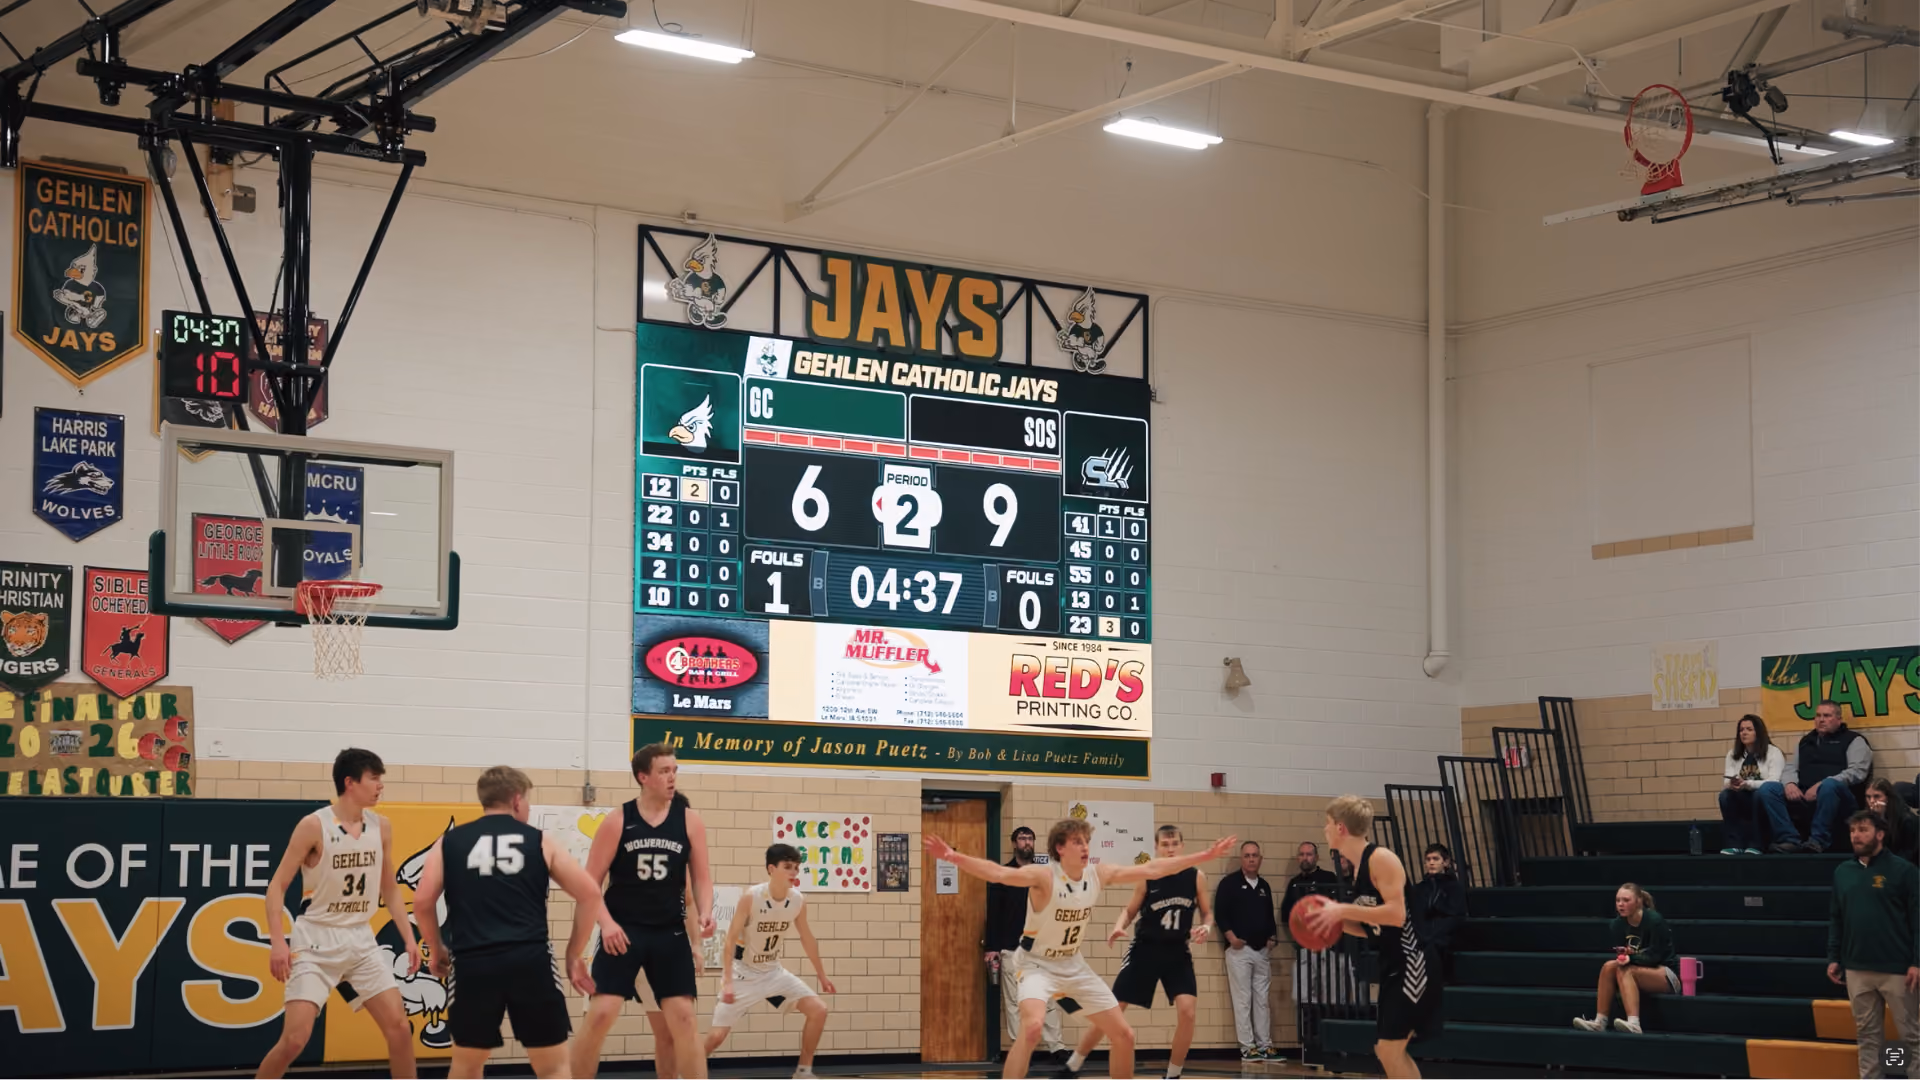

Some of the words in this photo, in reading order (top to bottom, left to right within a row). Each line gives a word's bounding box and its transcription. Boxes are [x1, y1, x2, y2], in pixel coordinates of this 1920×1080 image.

[36, 177, 132, 215] GEHLEN
[28, 208, 138, 247] CATHOLIC
[811, 257, 998, 358] JAYS
[43, 327, 116, 352] JAYS
[174, 315, 240, 346] 04:37
[197, 352, 240, 397] 10
[794, 350, 888, 384] GEHLEN
[892, 363, 1000, 396] CATHOLIC
[1002, 376, 1059, 402] JAYS
[750, 386, 773, 419] GC
[52, 417, 108, 437] HARRIS
[1024, 416, 1056, 448] SOS
[42, 436, 77, 454] LAKE
[81, 439, 116, 457] PARK
[307, 473, 357, 491] MCRU
[683, 465, 707, 476] PTS
[712, 468, 737, 479] FLS
[887, 473, 928, 486] PERIOD
[649, 477, 672, 497] 12
[690, 483, 700, 497] 2
[720, 485, 730, 500] 0
[792, 465, 830, 531] 6
[42, 499, 115, 519] WOLVES
[647, 504, 673, 524] 22
[689, 510, 700, 525] 0
[719, 512, 730, 527] 1
[896, 494, 919, 536] 2
[983, 483, 1018, 547] 9
[1099, 504, 1120, 515] PTS
[1124, 507, 1145, 517] FLS
[204, 522, 263, 543] GEORGE
[1071, 516, 1090, 534] 41
[1105, 521, 1114, 534] 1
[1130, 523, 1140, 536] 0
[198, 541, 235, 560] LITTLE
[647, 531, 673, 552] 34
[689, 537, 700, 551] 0
[719, 539, 730, 554] 0
[1069, 540, 1092, 559] 45
[1105, 545, 1114, 559] 0
[1130, 548, 1140, 561] 0
[303, 548, 352, 564] OYALS
[751, 550, 804, 567] FOULS
[0, 570, 62, 589] RINITY
[653, 559, 667, 579] 2
[688, 564, 699, 579] 0
[719, 566, 730, 581] 0
[1006, 570, 1054, 586] FOULS
[1069, 566, 1092, 584] 55
[1105, 570, 1114, 584] 0
[1130, 573, 1140, 586] 0
[94, 576, 148, 595] SIBLE
[765, 571, 789, 614] 1
[813, 577, 823, 589] B
[850, 565, 963, 614] 04:37
[0, 590, 64, 608] HRISTIAN
[92, 597, 150, 614] OCHEYED
[648, 587, 671, 607] 10
[688, 591, 699, 606] 0
[718, 593, 730, 608] 0
[988, 590, 997, 602] B
[1071, 591, 1090, 608] 13
[1105, 595, 1114, 608] 0
[1130, 597, 1140, 610] 1
[1019, 590, 1041, 630] 0
[1069, 616, 1092, 634] 23
[1106, 621, 1115, 633] 3
[1130, 622, 1140, 635] 0
[855, 628, 889, 645] MR.
[1053, 641, 1078, 652] SINCE
[1082, 643, 1102, 652] 1984
[845, 644, 929, 662] MUFFLER
[0, 658, 59, 675] IGERS
[93, 666, 156, 680] GENERALS
[681, 656, 740, 671] BROTHERS
[1767, 655, 1800, 686] the
[1009, 654, 1145, 703] RED'S
[0, 691, 15, 719] E
[118, 692, 178, 720] FOUR
[673, 694, 691, 708] Le
[693, 695, 732, 709] Mars
[1017, 700, 1101, 719] PRINTING
[1107, 705, 1137, 720] CO.
[663, 731, 684, 748] In
[694, 732, 775, 756] Memory
[783, 736, 806, 757] of
[811, 737, 867, 755] Jason
[876, 739, 928, 760] Puetz
[947, 747, 963, 761] By
[968, 748, 992, 760] Bob
[997, 749, 1007, 761] &
[1013, 750, 1040, 762] Lisa
[1045, 751, 1079, 764] Puetz
[1083, 752, 1125, 767] Family
[29, 765, 93, 796] LAST
[96, 768, 192, 797] QUARTER
[796, 820, 840, 839] KEEP
[467, 833, 525, 876] 45
[624, 838, 683, 854] WOLVERINES
[1101, 840, 1115, 849] LOVE
[333, 851, 376, 869] GEHLEN
[798, 845, 864, 865] GHTING
[1034, 855, 1049, 864] TICE
[0, 844, 39, 888] E
[66, 843, 147, 889] OF
[170, 844, 270, 887] THE
[637, 854, 669, 880] 55
[342, 872, 366, 896] 34
[327, 900, 370, 913] CATHOLIC
[1161, 909, 1180, 930] 41
[1061, 926, 1080, 946] 12
[0, 893, 295, 1034] AYS
